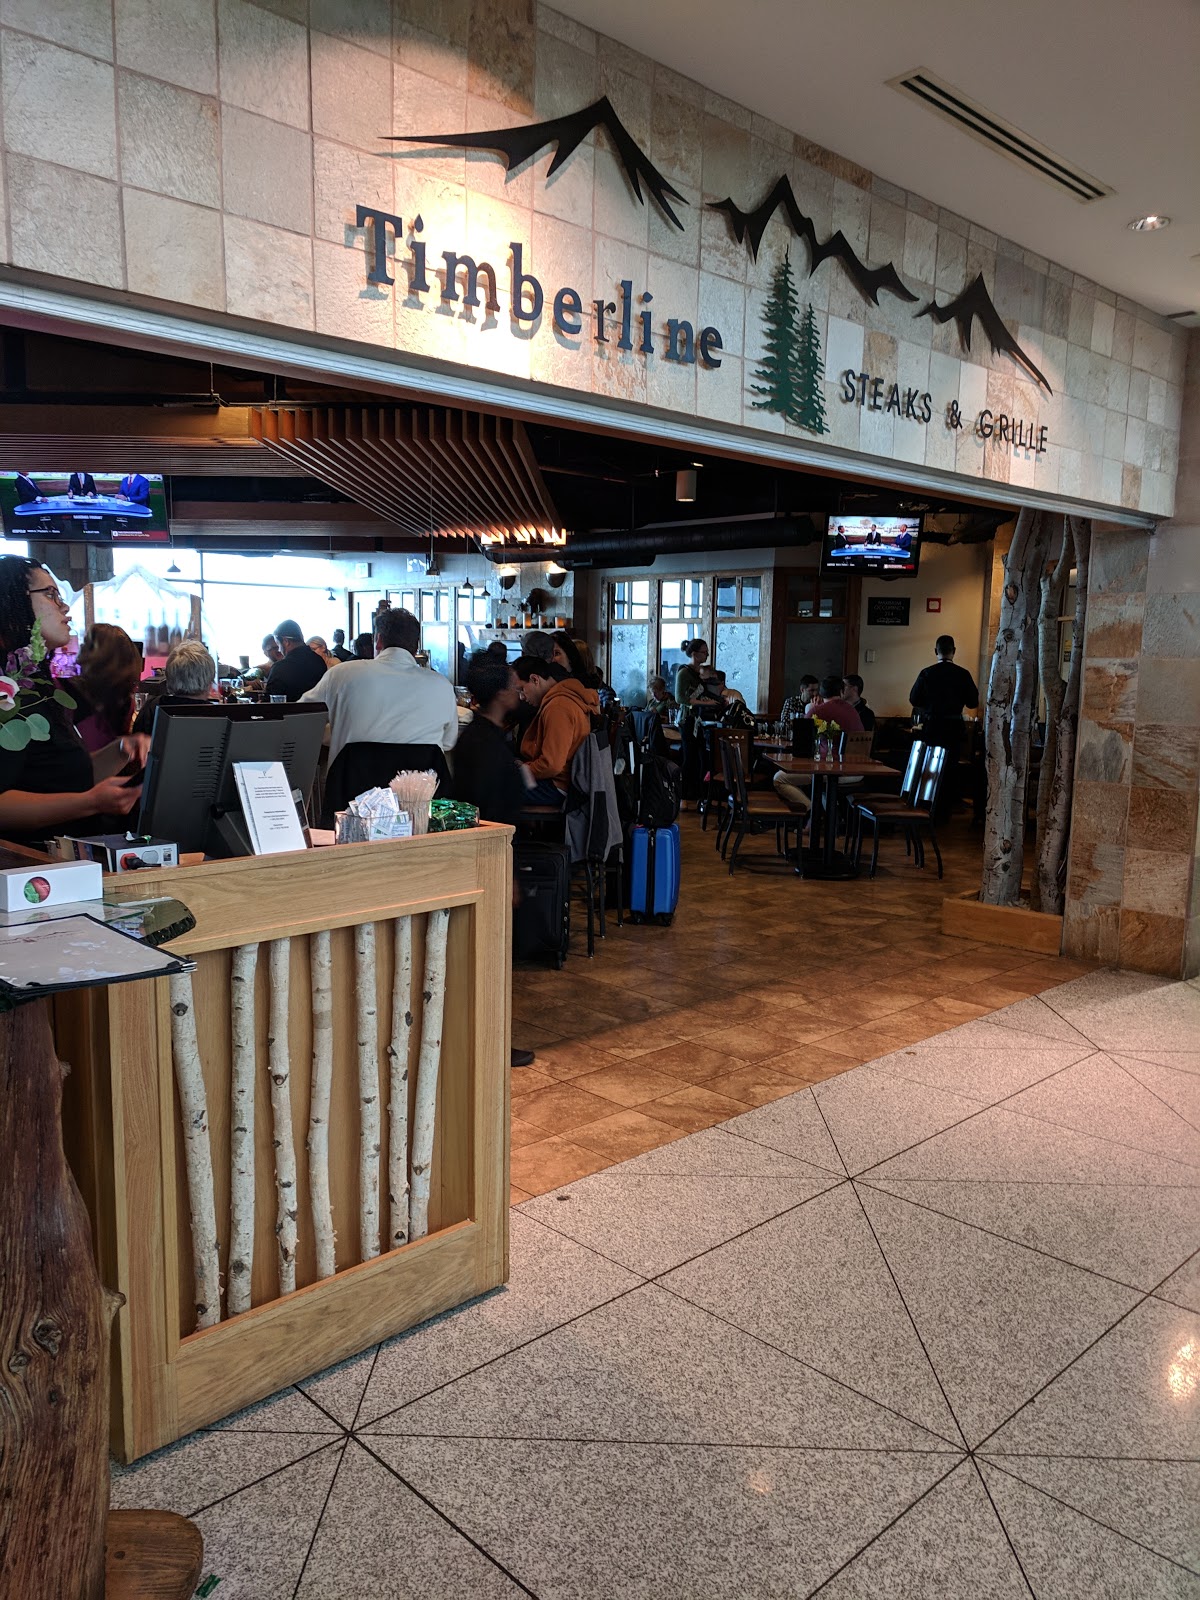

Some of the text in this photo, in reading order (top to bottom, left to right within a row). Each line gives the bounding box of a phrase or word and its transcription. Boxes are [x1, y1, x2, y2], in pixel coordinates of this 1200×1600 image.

[355, 204, 723, 368] Timberline
[844, 369, 1049, 453] STEAKS & GRILLE
